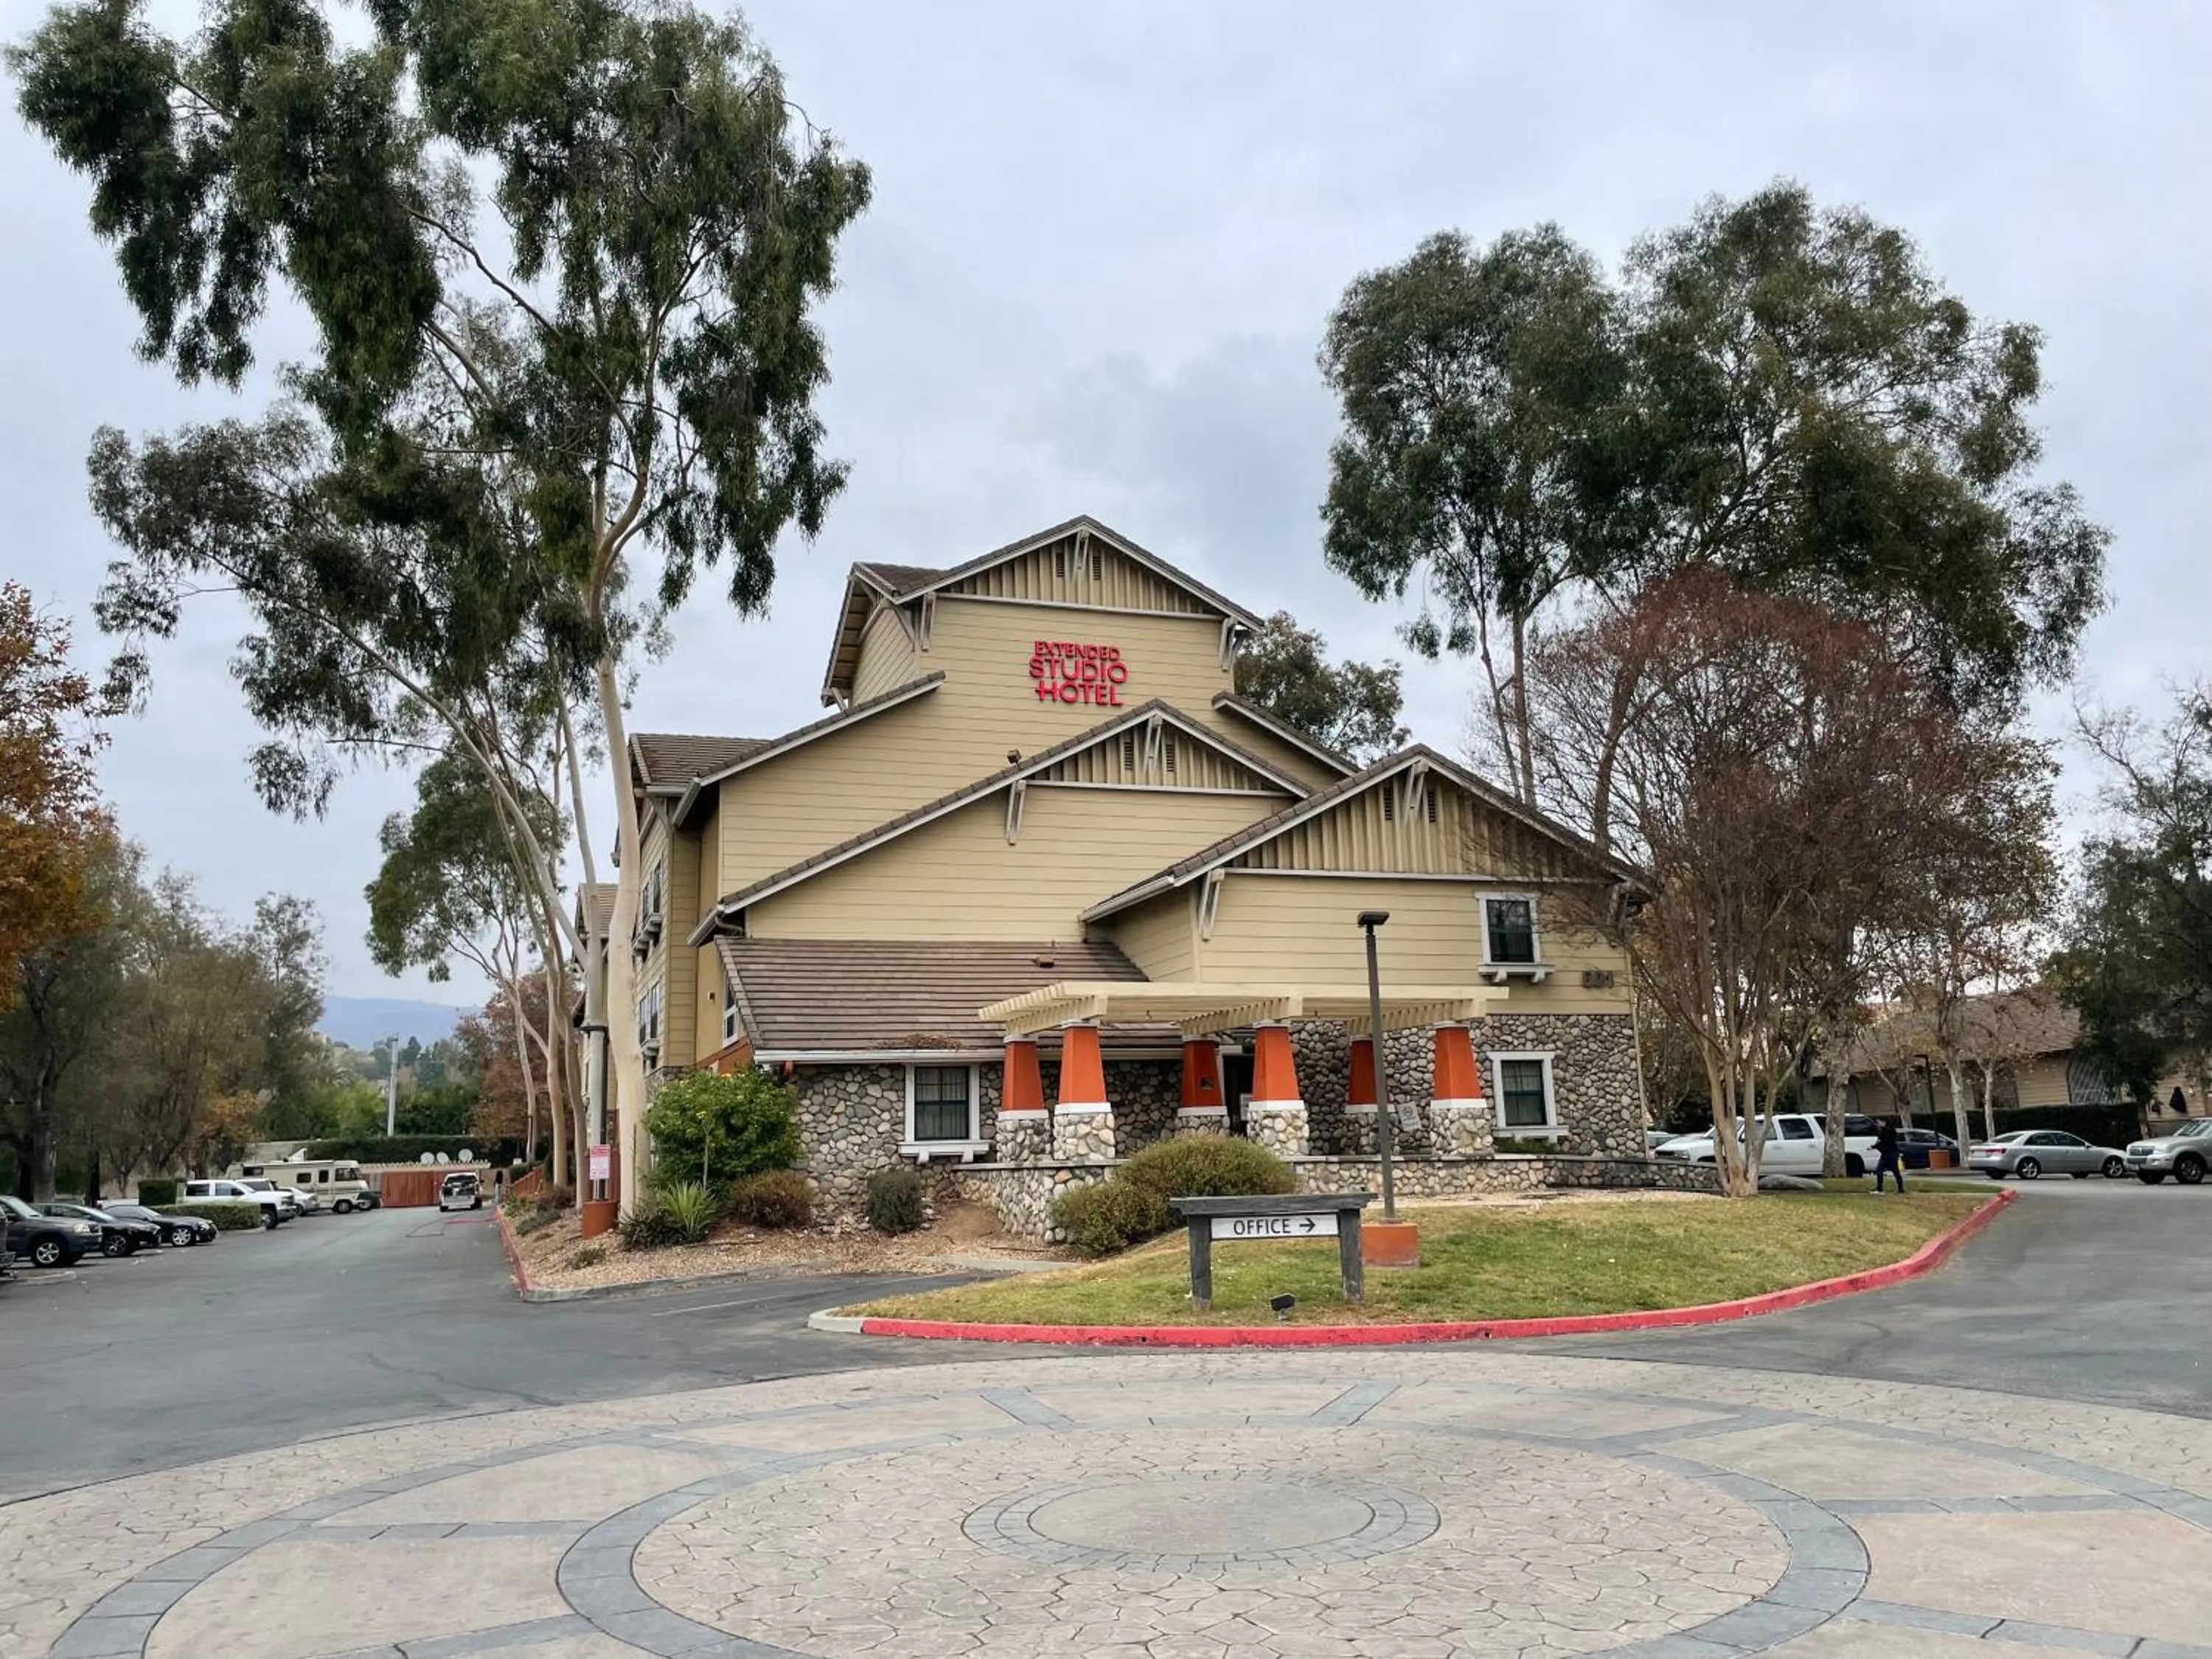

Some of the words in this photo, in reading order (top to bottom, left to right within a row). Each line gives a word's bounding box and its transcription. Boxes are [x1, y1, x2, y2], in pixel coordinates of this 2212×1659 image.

[1034, 640, 1120, 661] EXTENDED
[1029, 654, 1128, 684] STUDIO
[1034, 680, 1124, 707] HOTEL
[1234, 1219, 1290, 1235] OFFICE
